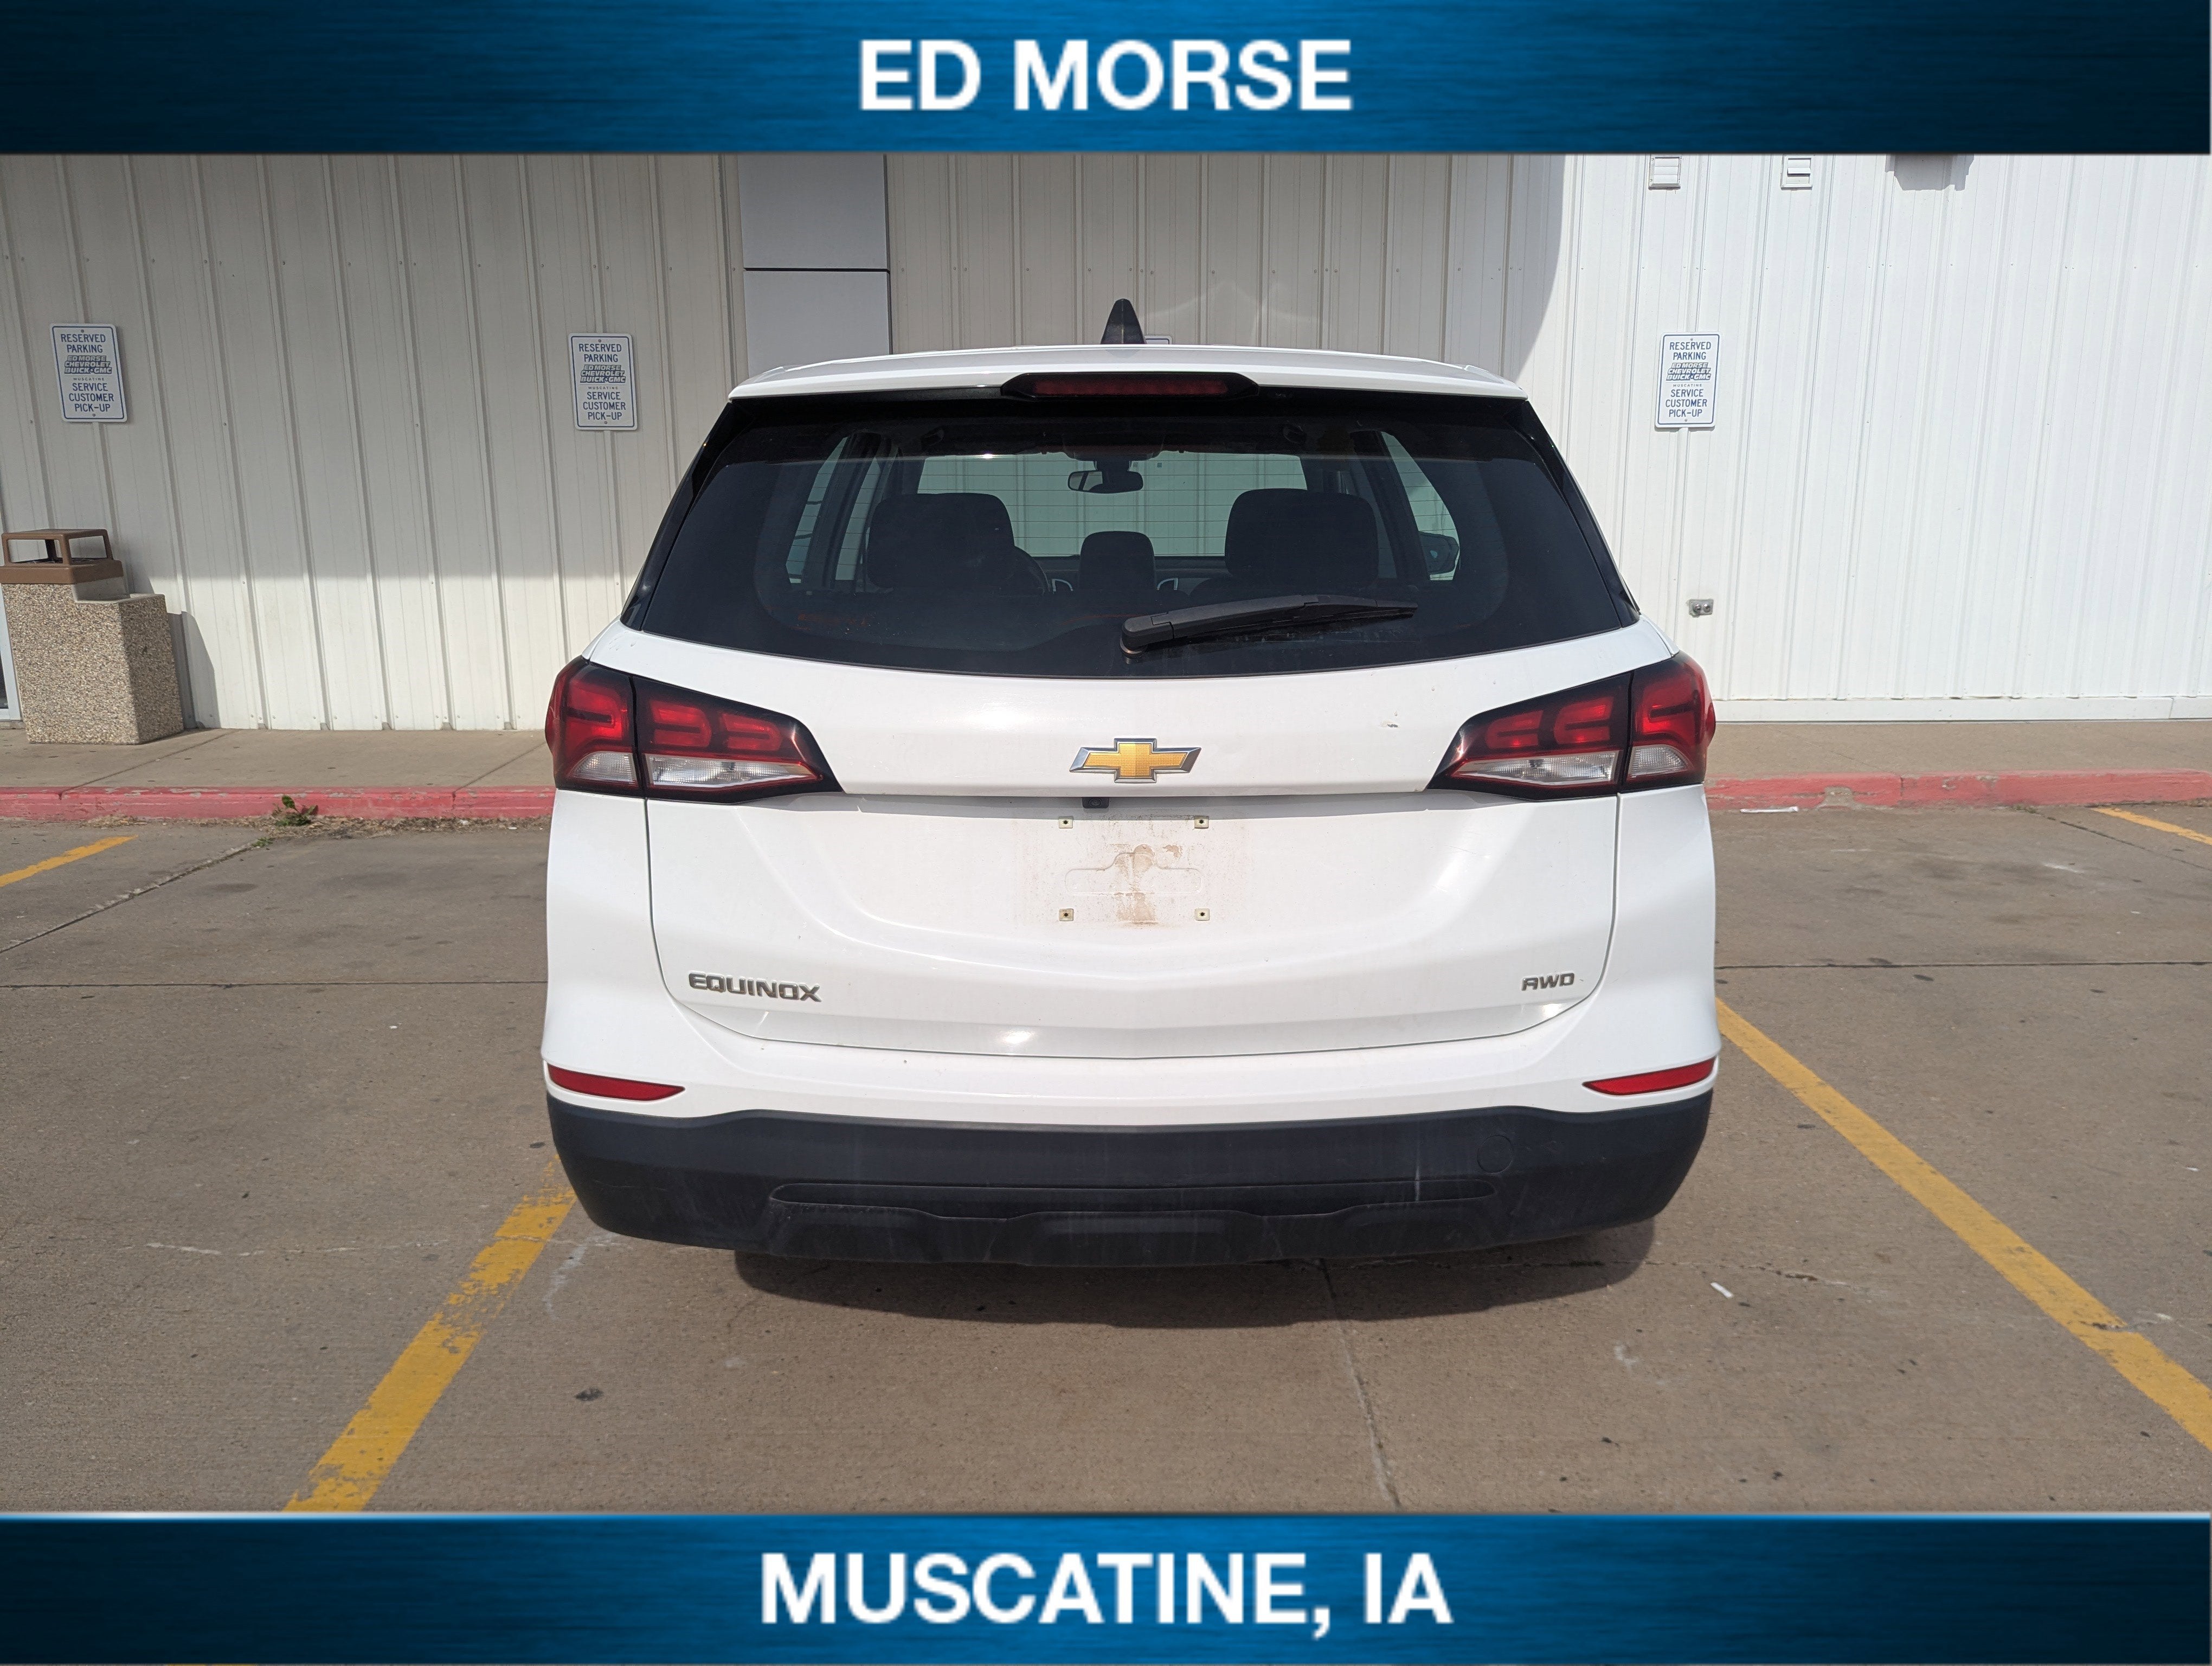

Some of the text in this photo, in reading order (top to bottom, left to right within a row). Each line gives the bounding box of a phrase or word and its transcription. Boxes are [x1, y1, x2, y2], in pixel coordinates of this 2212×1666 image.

[61, 334, 106, 342] RESERVED
[579, 344, 621, 352] RESERVED
[1670, 342, 1711, 350] RESERVED
[584, 354, 618, 362] PARKING
[1673, 352, 1706, 360] PARKING
[73, 383, 108, 391] SERVICE
[69, 393, 114, 401] CUSTOMER
[587, 392, 621, 400] SERVICE
[1671, 389, 1703, 397] SERVICE
[583, 402, 626, 410] CUSTOMER
[1666, 399, 1707, 407] CUSTOMER
[75, 403, 110, 412] PICK-UP
[1521, 972, 1574, 991] AWD
[688, 972, 822, 1002] EQUINOX
